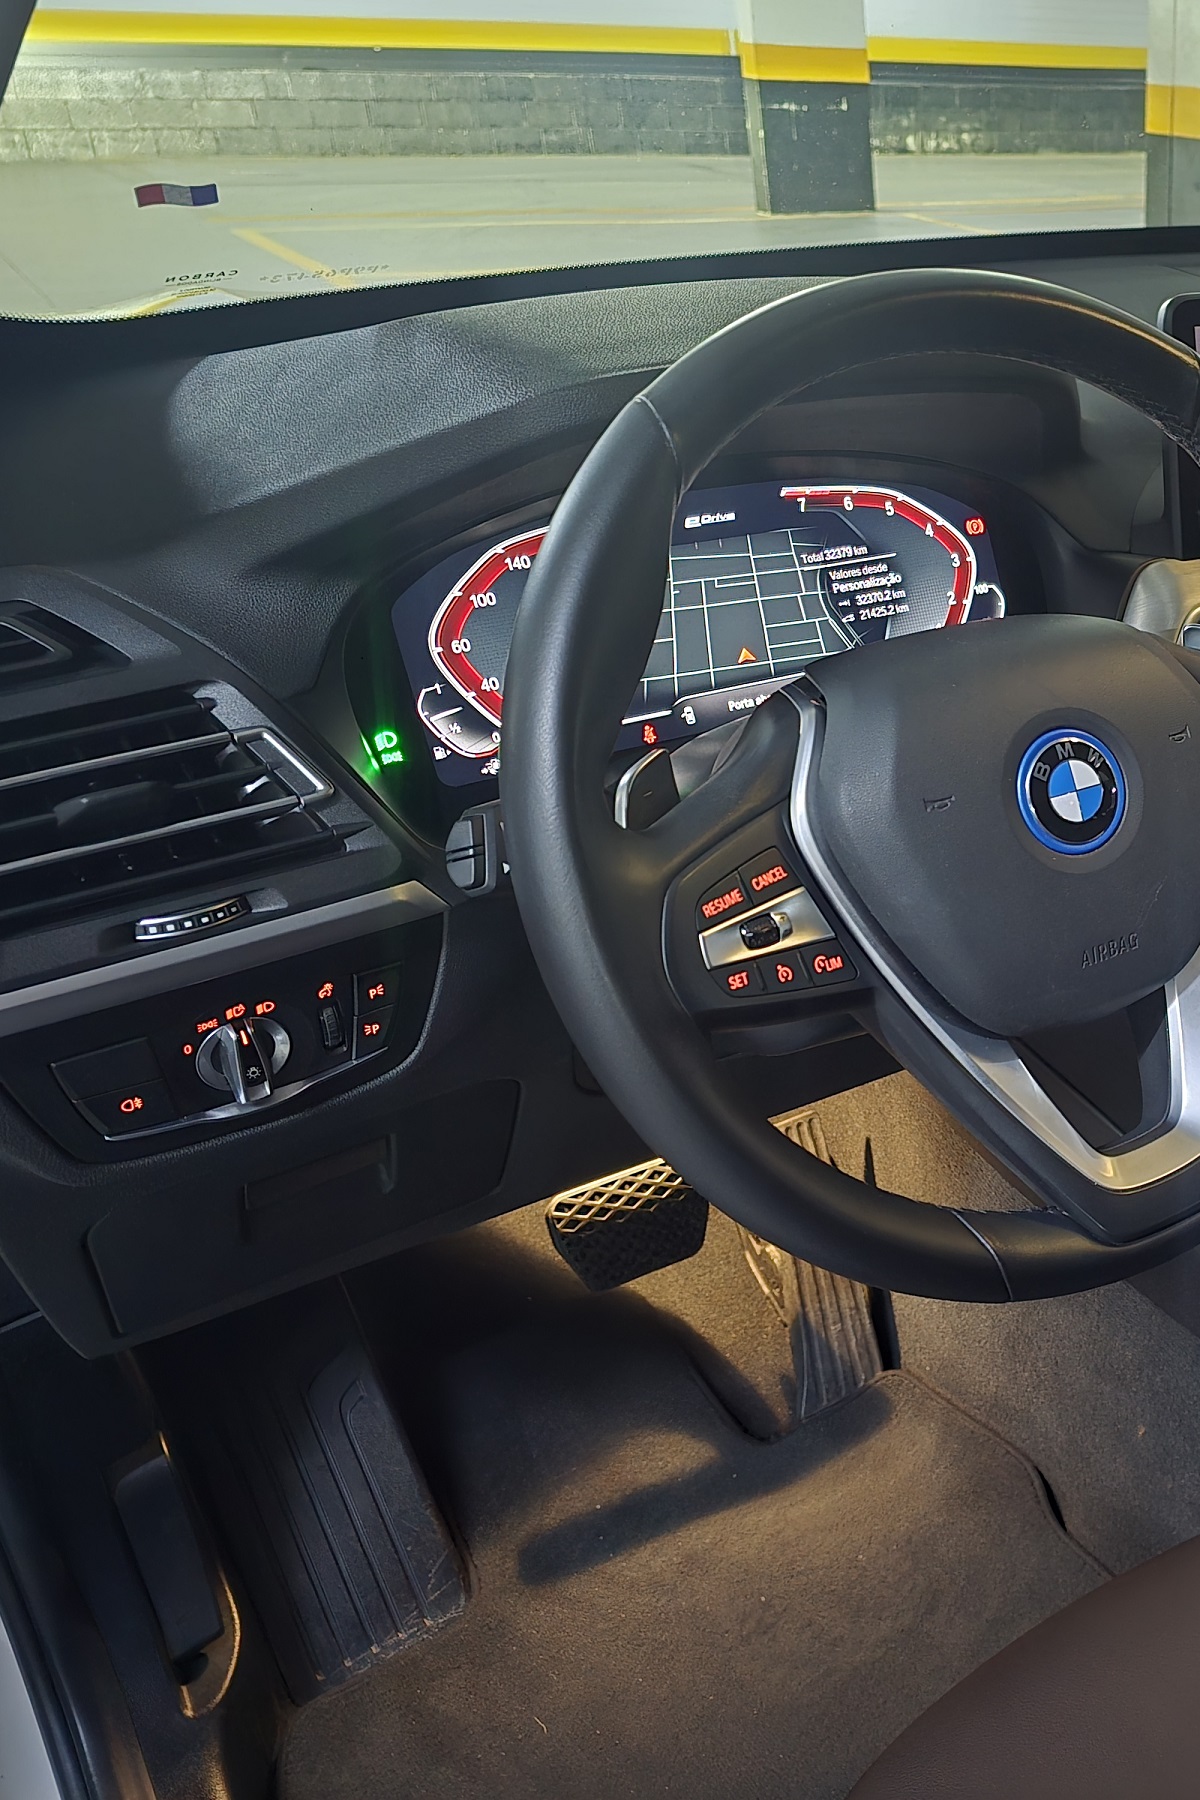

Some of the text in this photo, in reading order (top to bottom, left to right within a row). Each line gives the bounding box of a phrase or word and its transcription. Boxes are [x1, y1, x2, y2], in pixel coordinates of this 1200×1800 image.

[797, 497, 806, 513] 7
[843, 496, 854, 511] 6
[884, 501, 895, 516] 5
[925, 523, 934, 537] 4
[504, 555, 532, 571] 140
[801, 546, 869, 564] Total 32379 km
[951, 553, 961, 568] 3
[828, 563, 889, 580] Valores desde
[832, 572, 903, 594] Personalização
[469, 592, 496, 609] 100
[892, 589, 907, 599] km
[946, 591, 957, 605] 2
[896, 603, 910, 613] km
[451, 638, 471, 654] 60
[480, 676, 500, 692] 40
[728, 698, 755, 712] Porta
[1033, 742, 1105, 782] BMW
[751, 865, 788, 892] CANCEL
[702, 888, 744, 918] RESUME
[1081, 932, 1139, 969] AIRBAG
[727, 971, 749, 990] SET
